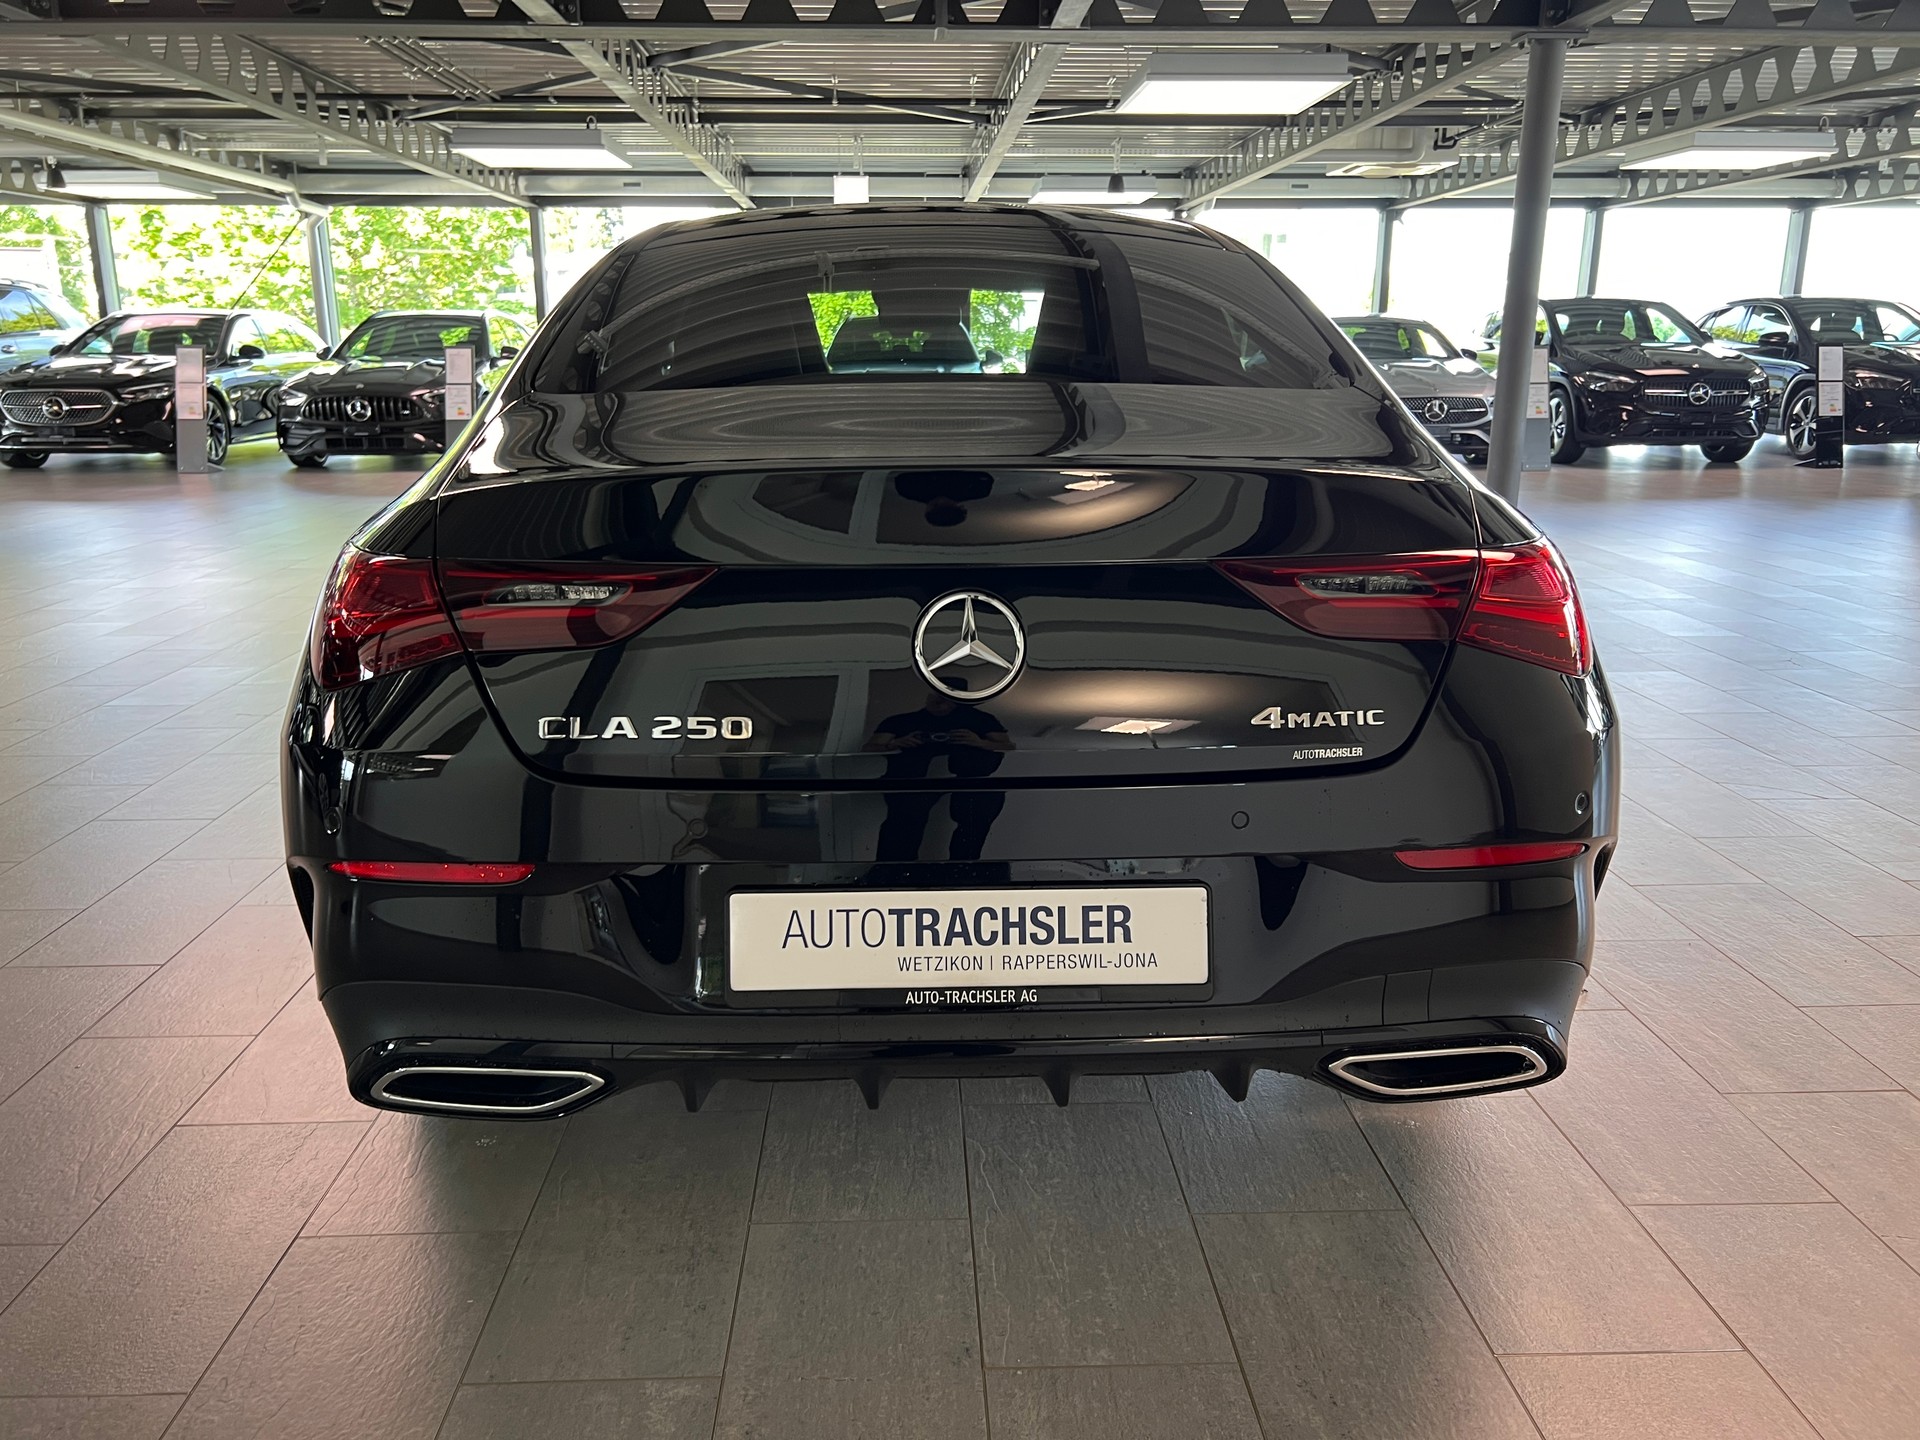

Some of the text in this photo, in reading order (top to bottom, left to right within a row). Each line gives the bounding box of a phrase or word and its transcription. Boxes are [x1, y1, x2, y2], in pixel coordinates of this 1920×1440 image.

[538, 715, 754, 740] CLA 250
[1250, 706, 1386, 730] 4MATIC
[1292, 747, 1363, 760] AUTOTRACHSLER
[781, 904, 1133, 950] AUTOTRACHSLER
[897, 955, 983, 973] WETZIKON
[1002, 952, 1159, 971] RAPPERSWIL-JONA
[905, 989, 1038, 1005] AUTO-TRACHSLER AG
